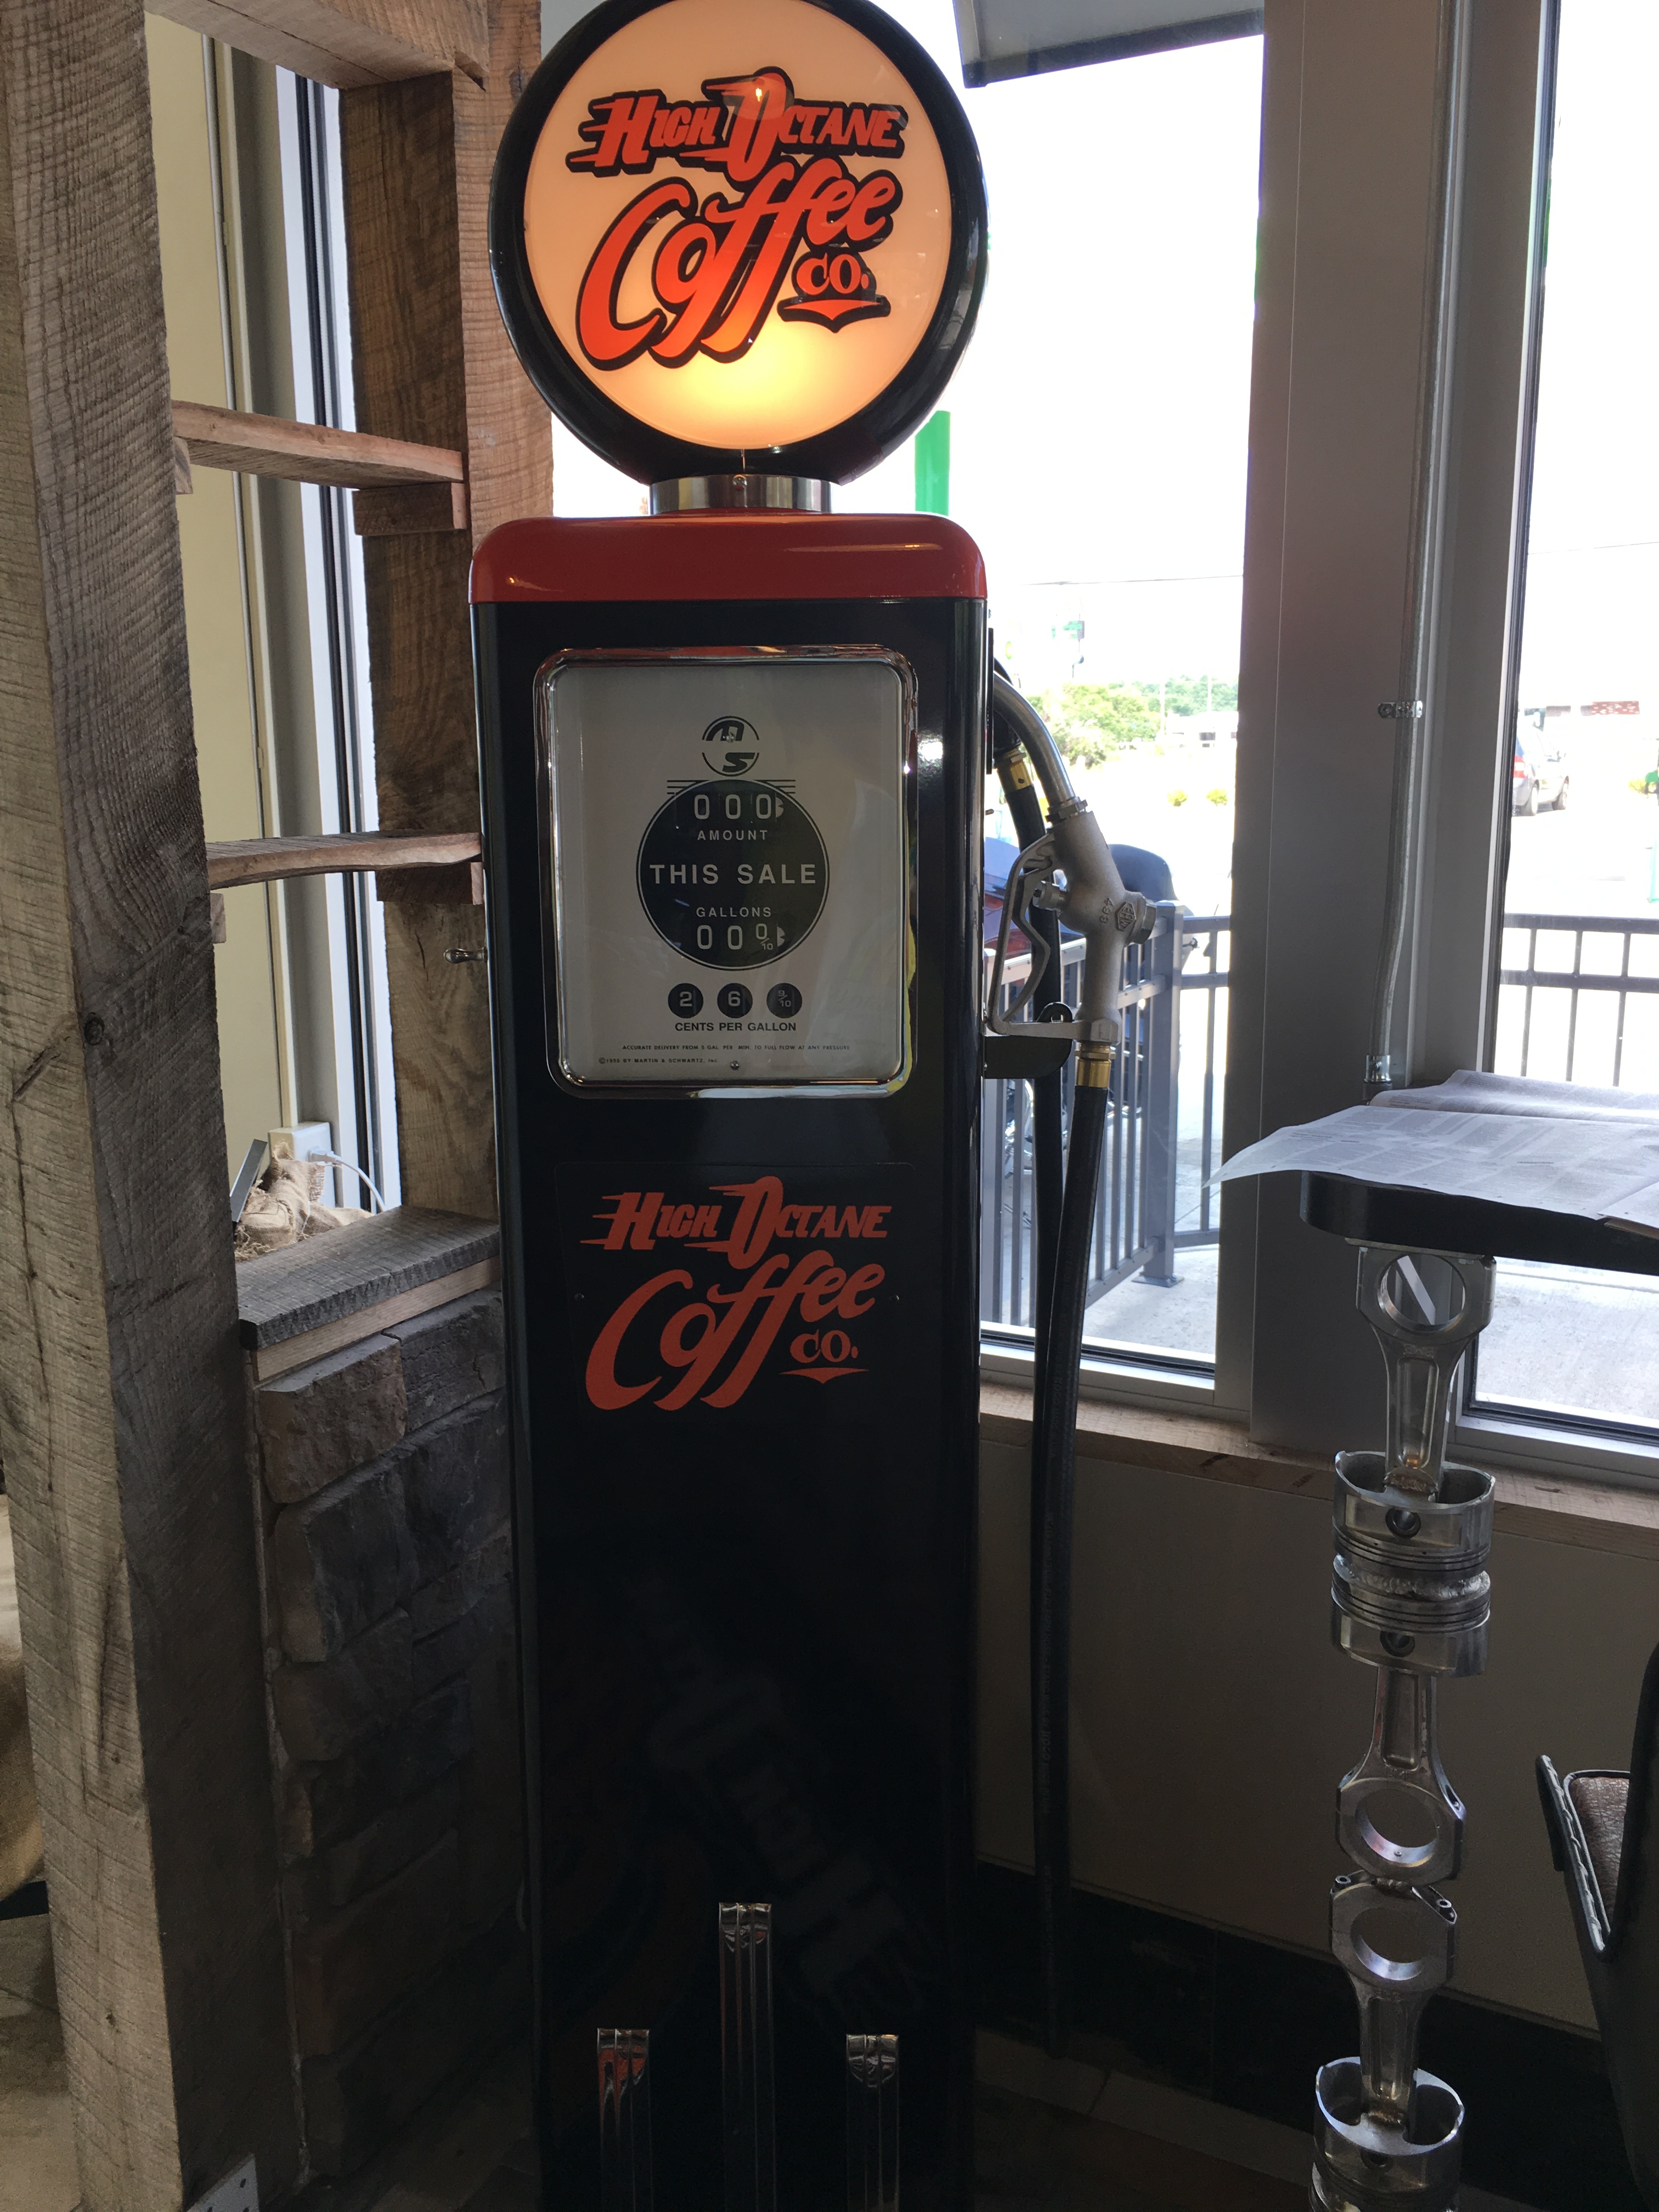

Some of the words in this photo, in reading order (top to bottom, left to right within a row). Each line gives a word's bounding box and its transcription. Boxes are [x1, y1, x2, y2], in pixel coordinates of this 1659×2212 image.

[575, 156, 902, 370] Coffee
[697, 830, 768, 840] AMOUNT
[650, 864, 719, 884] THIS
[737, 864, 816, 884] SALE
[696, 907, 772, 917] GALLONS
[675, 1023, 714, 1031] CENTS
[719, 1023, 742, 1031] PER
[747, 1023, 797, 1031] GALLON
[585, 1249, 885, 1411] Coffee
